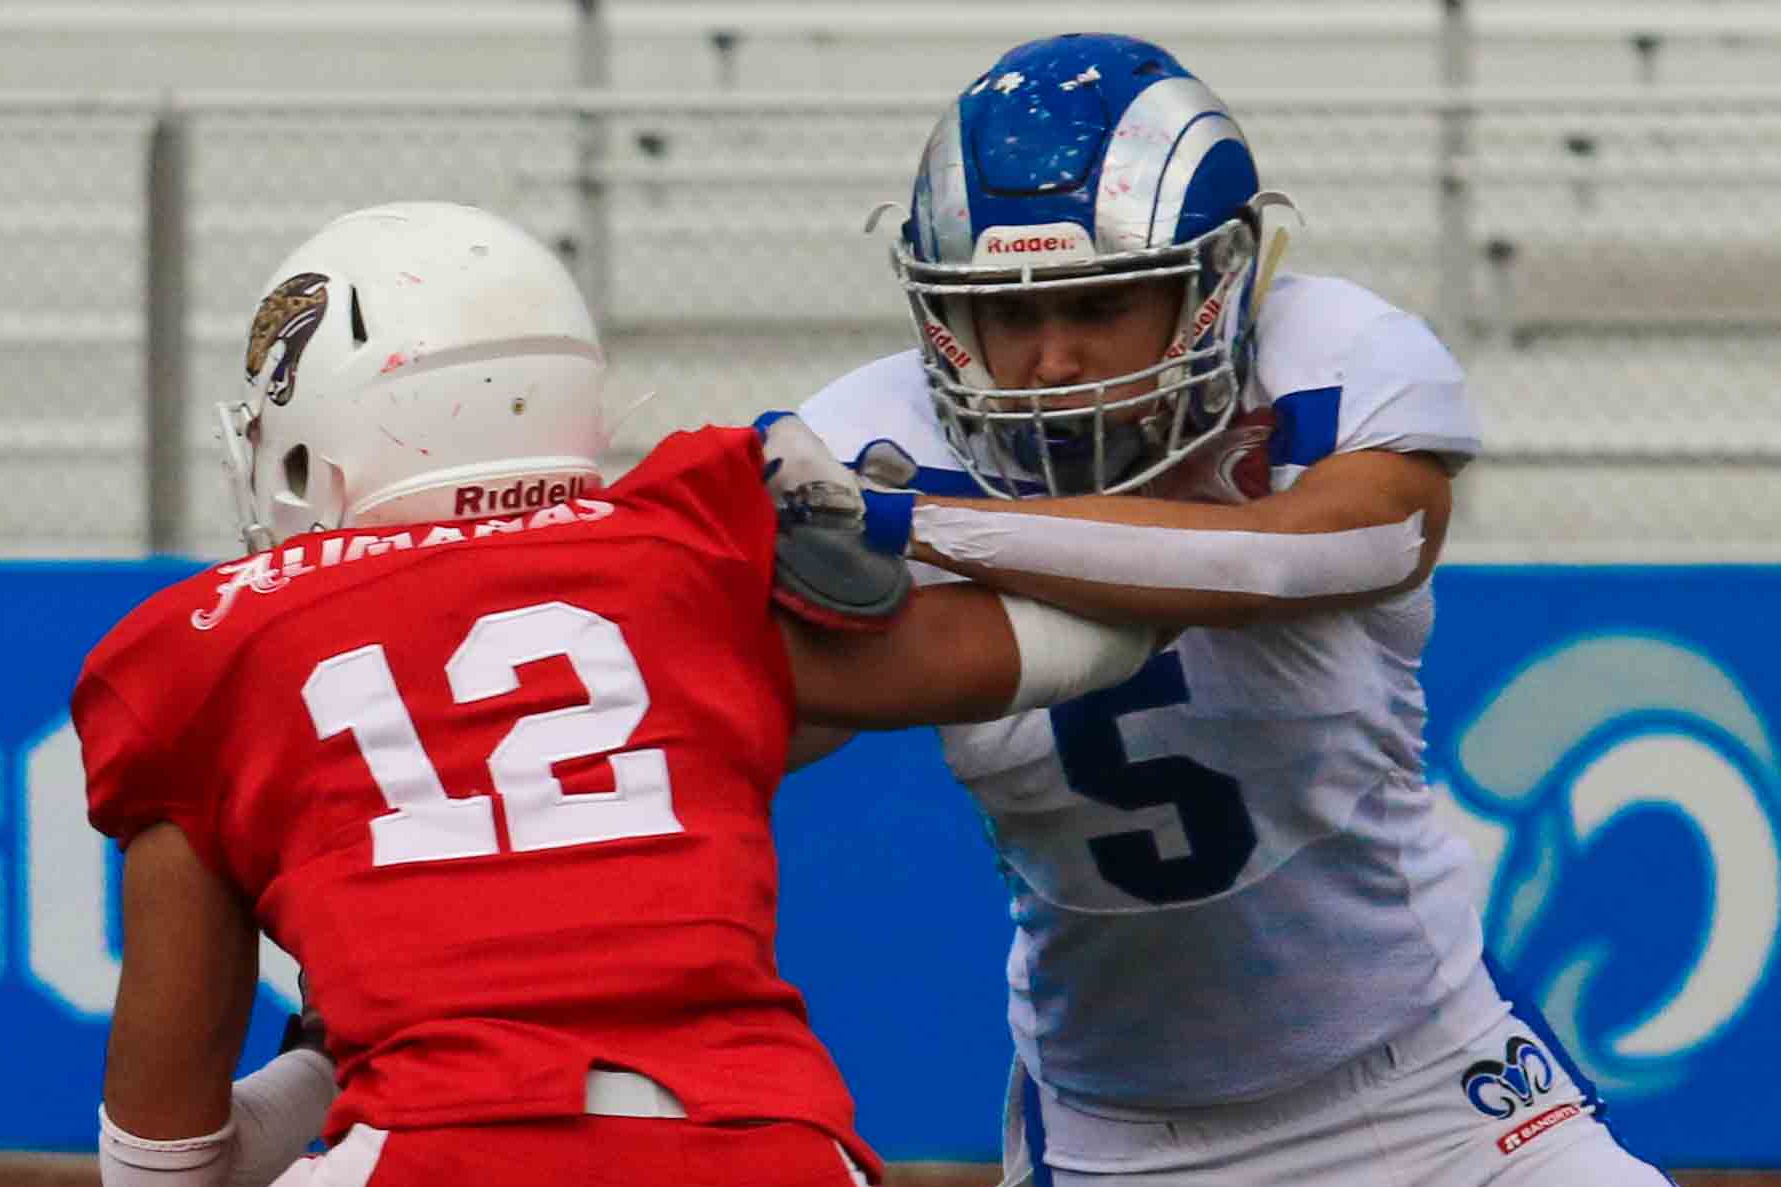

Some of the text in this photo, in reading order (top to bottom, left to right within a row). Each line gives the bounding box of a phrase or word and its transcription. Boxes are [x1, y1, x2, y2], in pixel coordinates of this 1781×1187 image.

[923, 320, 972, 368] ddell
[1164, 297, 1222, 359] Rdell
[455, 476, 584, 516] Riddell
[301, 601, 685, 867] 12
[1049, 650, 1259, 905] 5
